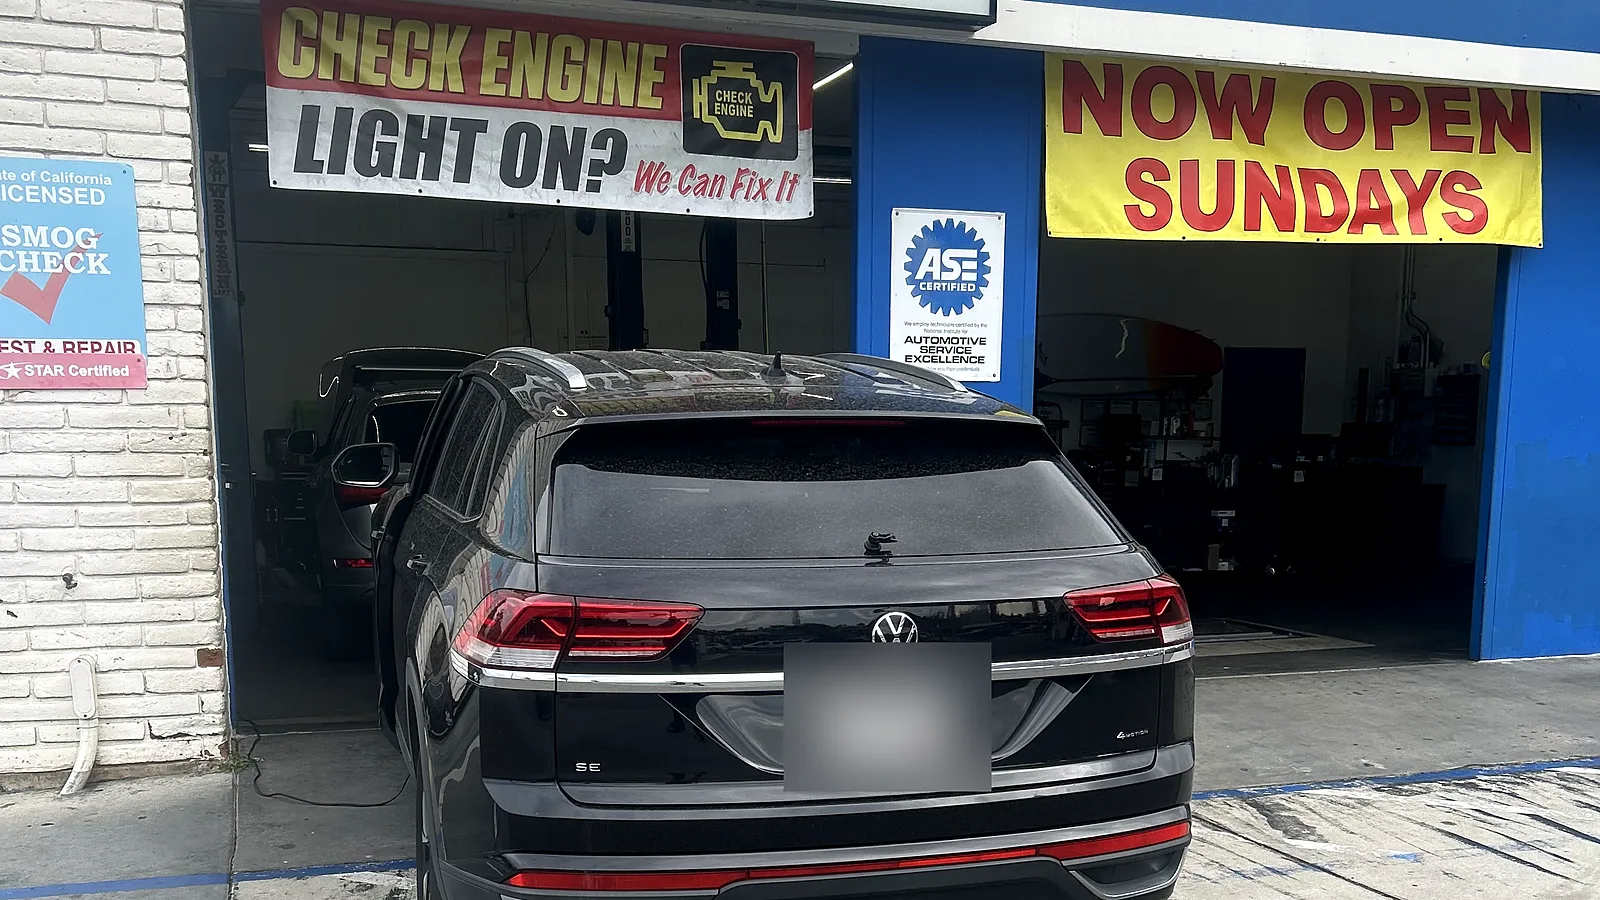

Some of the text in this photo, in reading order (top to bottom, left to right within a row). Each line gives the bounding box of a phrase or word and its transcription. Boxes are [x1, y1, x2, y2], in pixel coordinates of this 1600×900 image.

[277, 6, 668, 109] CHECK ENGINE
[714, 89, 754, 118] CHECK ENGINE
[1062, 60, 1532, 154] NOW OPEN
[294, 104, 628, 194] LIGHT ON?
[0, 169, 112, 186] te of California
[633, 160, 800, 202] We Can Fix It
[0, 183, 106, 206] ICENSED
[1123, 157, 1489, 236] SUNDAYS
[1, 224, 99, 250] SMOG
[0, 249, 111, 275] CHECK
[914, 248, 978, 282] ASE
[919, 282, 976, 292] CERTIFIED
[43, 341, 55, 353] &
[63, 340, 136, 354] REPAIR
[904, 335, 987, 346] AUTOMOTIVE
[919, 345, 972, 354] SERVICE
[24, 364, 130, 377] STAR Certified
[904, 354, 986, 364] EXCELLENCE
[1116, 728, 1150, 740] 4MOTION
[575, 762, 601, 772] SE
